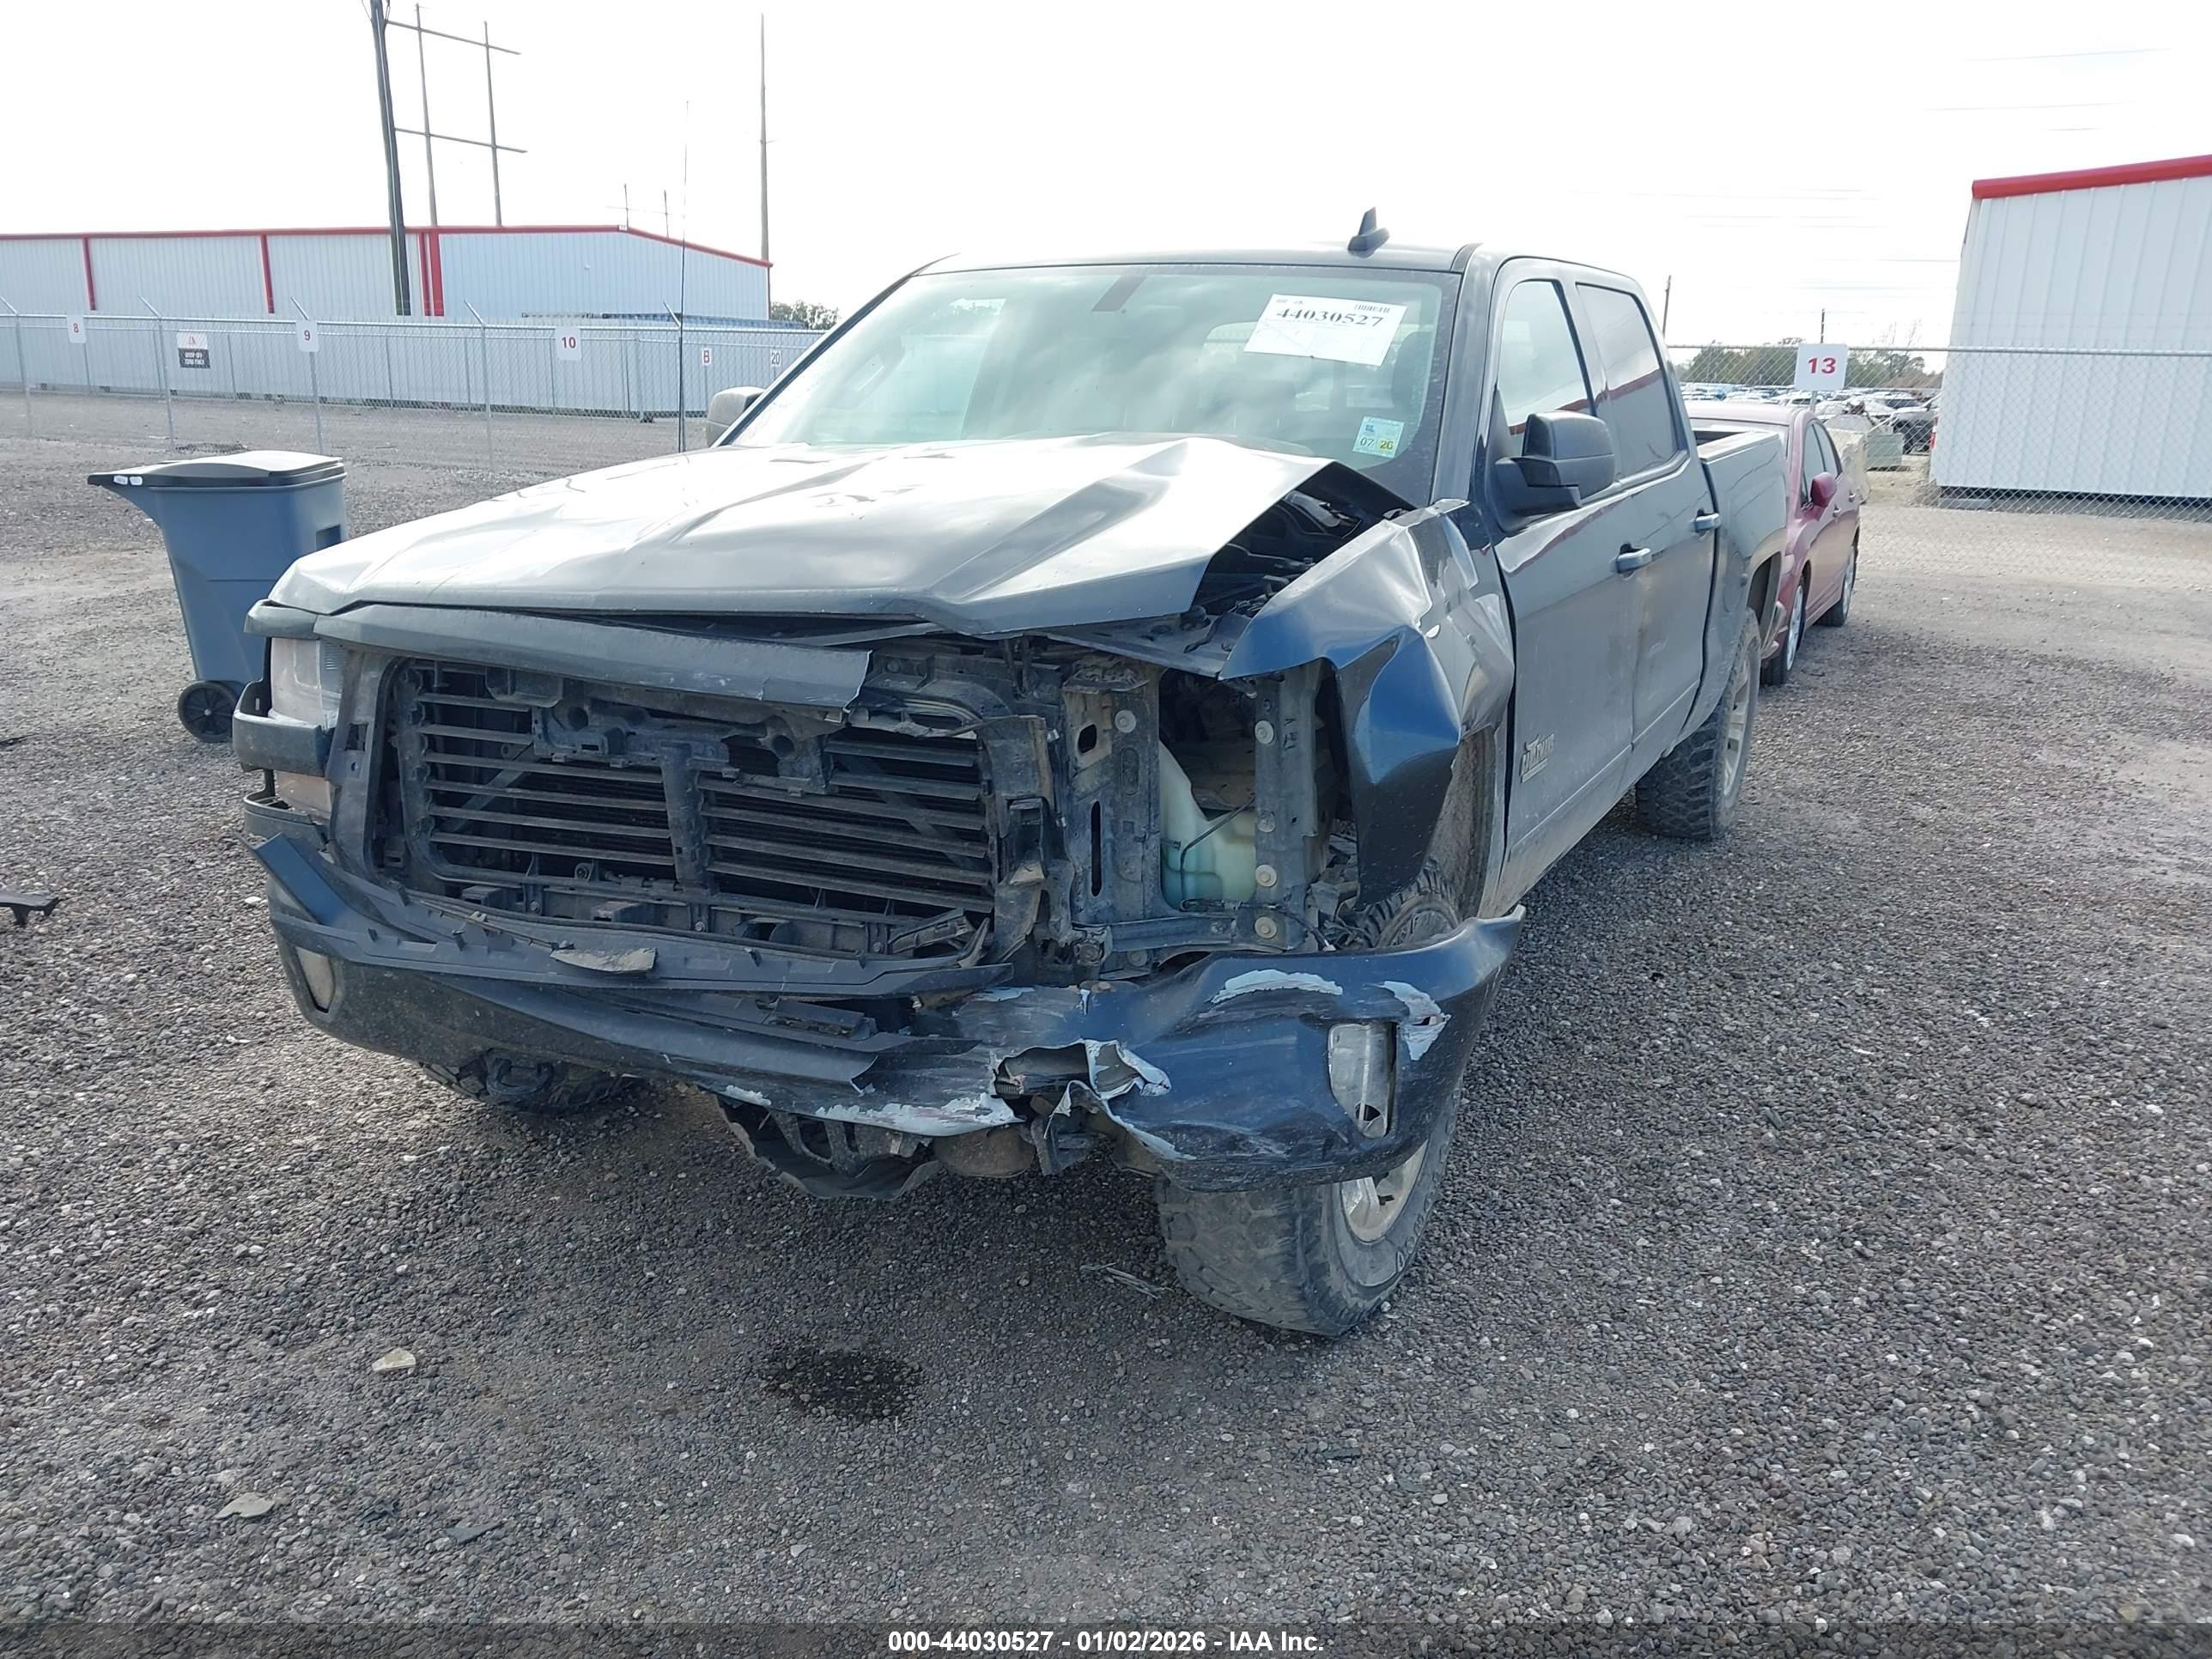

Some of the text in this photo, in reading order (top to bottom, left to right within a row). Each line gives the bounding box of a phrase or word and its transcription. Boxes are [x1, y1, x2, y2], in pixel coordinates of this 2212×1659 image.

[1276, 308, 1383, 327] 44030527
[73, 322, 79, 333] 8
[304, 330, 311, 341] 9
[562, 336, 576, 349] 10
[1808, 357, 1837, 374] 13
[1360, 436, 1375, 447] 07
